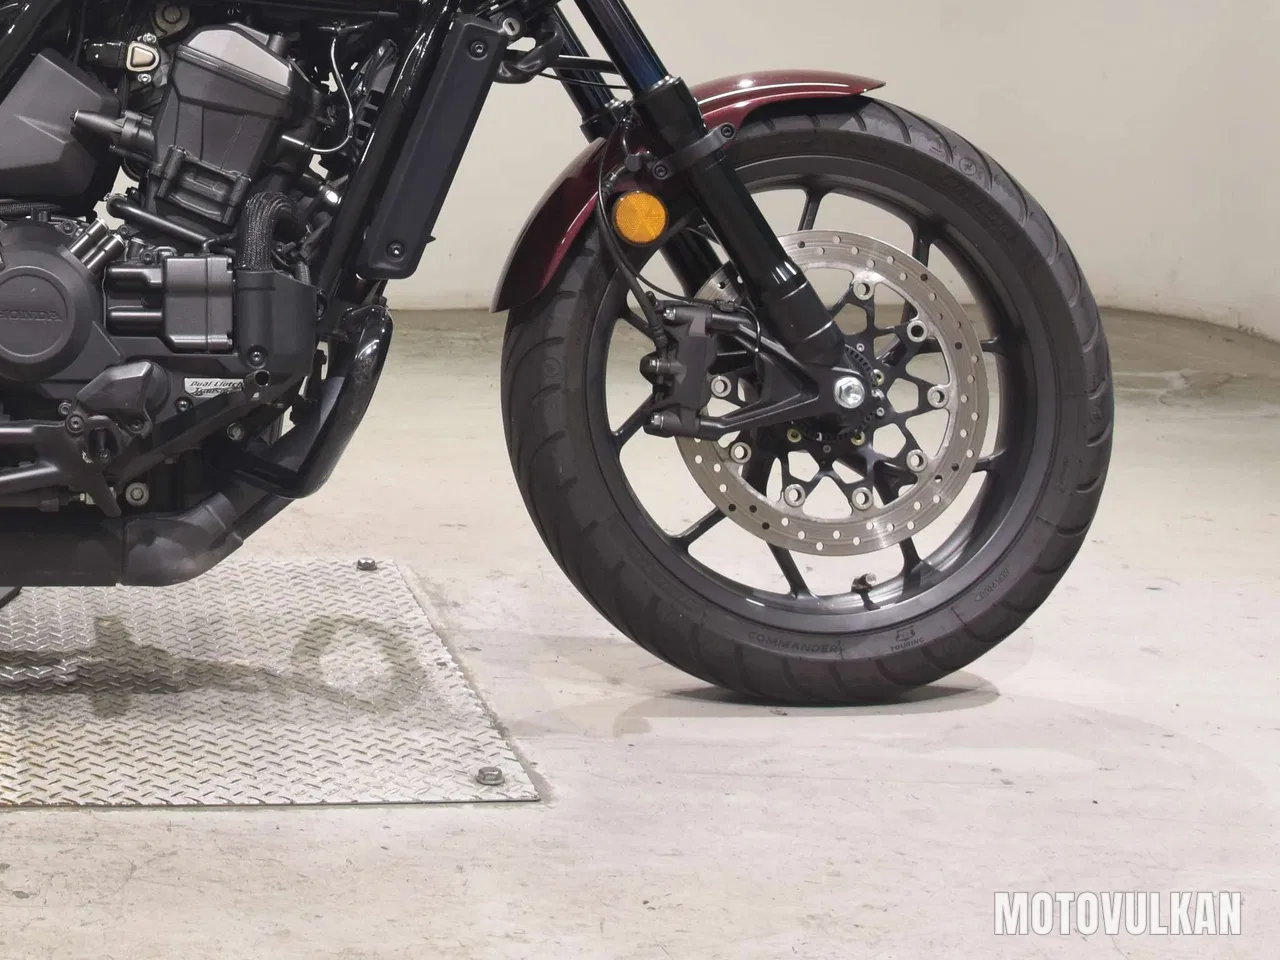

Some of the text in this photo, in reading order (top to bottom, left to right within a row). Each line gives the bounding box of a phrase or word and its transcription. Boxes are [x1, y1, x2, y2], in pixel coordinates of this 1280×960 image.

[213, 380, 243, 388] Clutch
[747, 630, 839, 654] COMMANDER
[889, 637, 925, 653] TOURING
